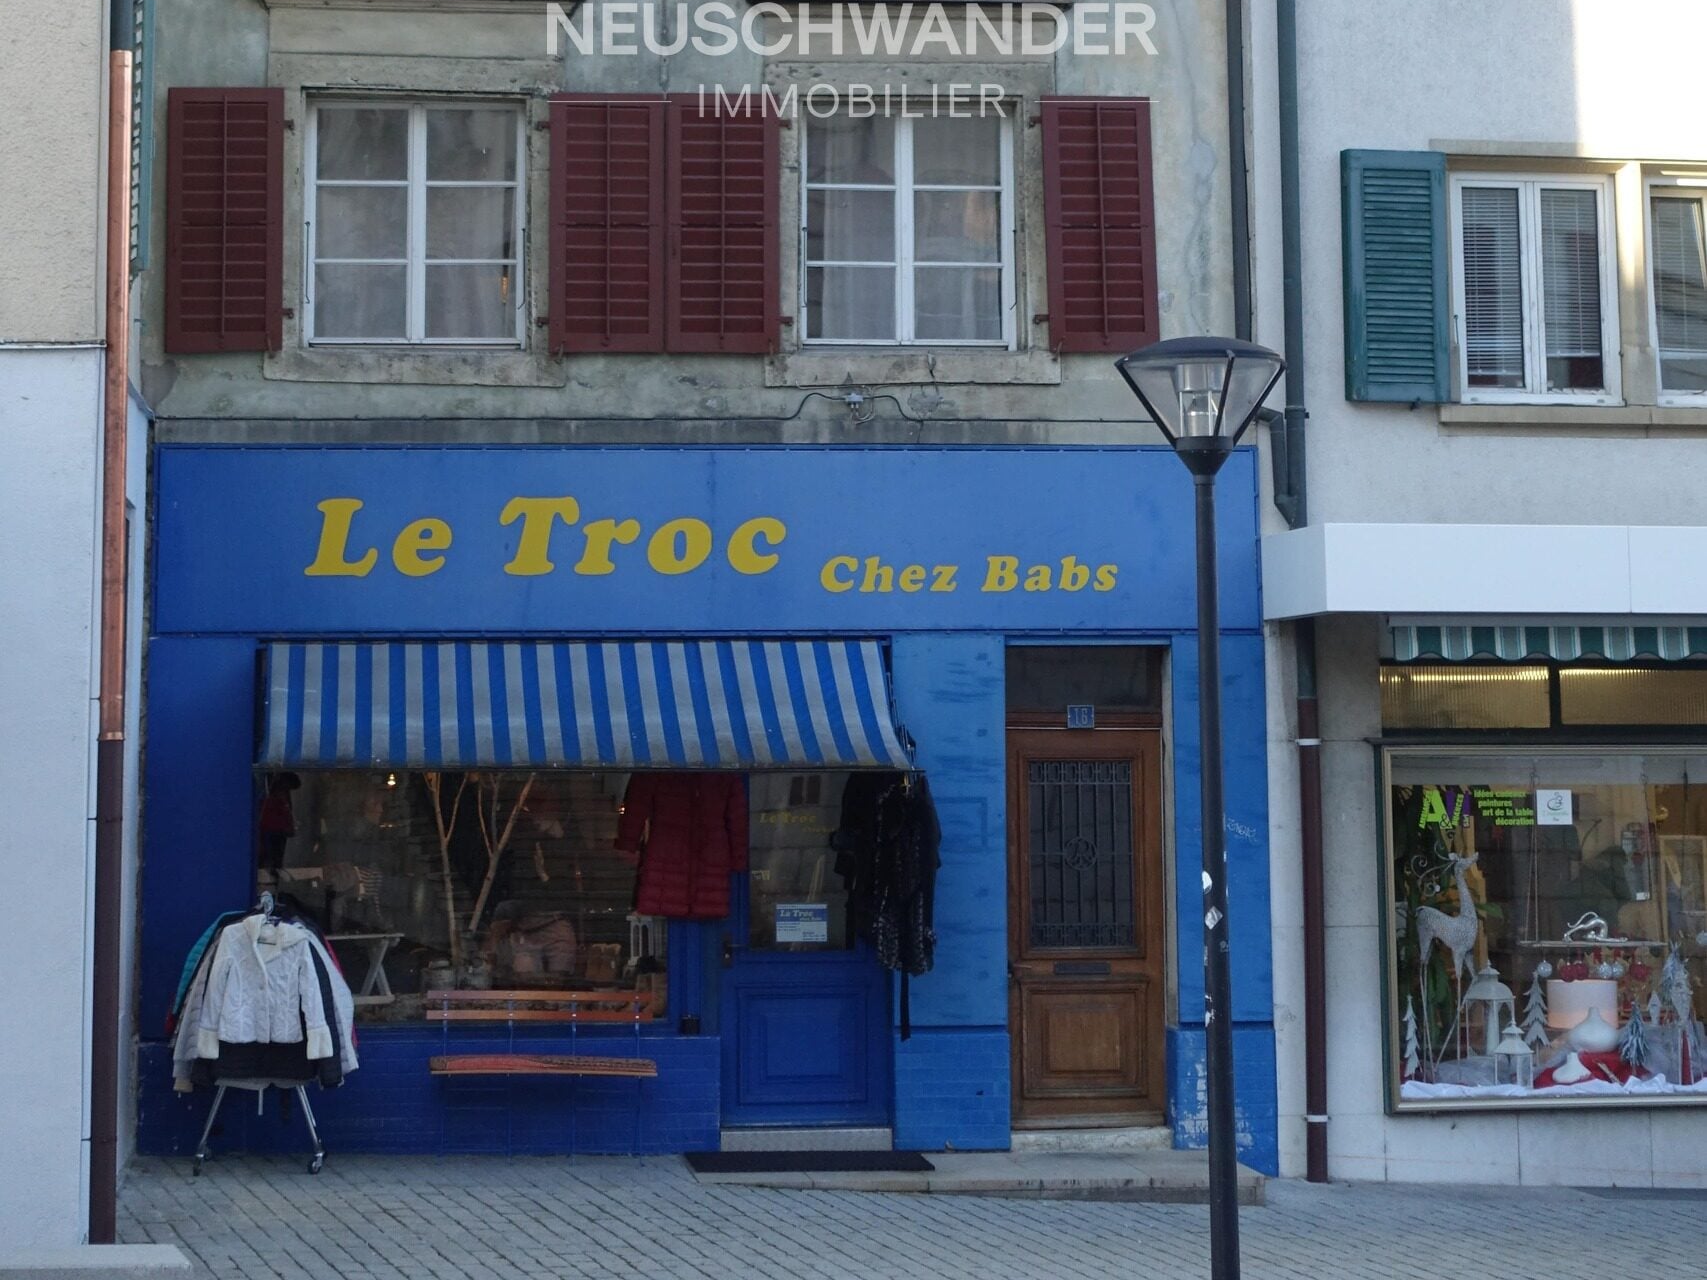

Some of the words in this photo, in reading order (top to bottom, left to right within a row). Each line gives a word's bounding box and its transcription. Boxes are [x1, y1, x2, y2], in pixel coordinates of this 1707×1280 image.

[304, 498, 453, 577] Le
[500, 496, 787, 576] Troc
[820, 555, 959, 593] Chez
[980, 555, 1118, 593] Babs
[1074, 708, 1088, 725] 16
[1478, 799, 1513, 808] peintures
[1482, 809, 1494, 817] art
[1495, 808, 1505, 816] de
[1506, 808, 1514, 816] la
[1515, 808, 1535, 816] table
[1495, 817, 1535, 826] décoration
